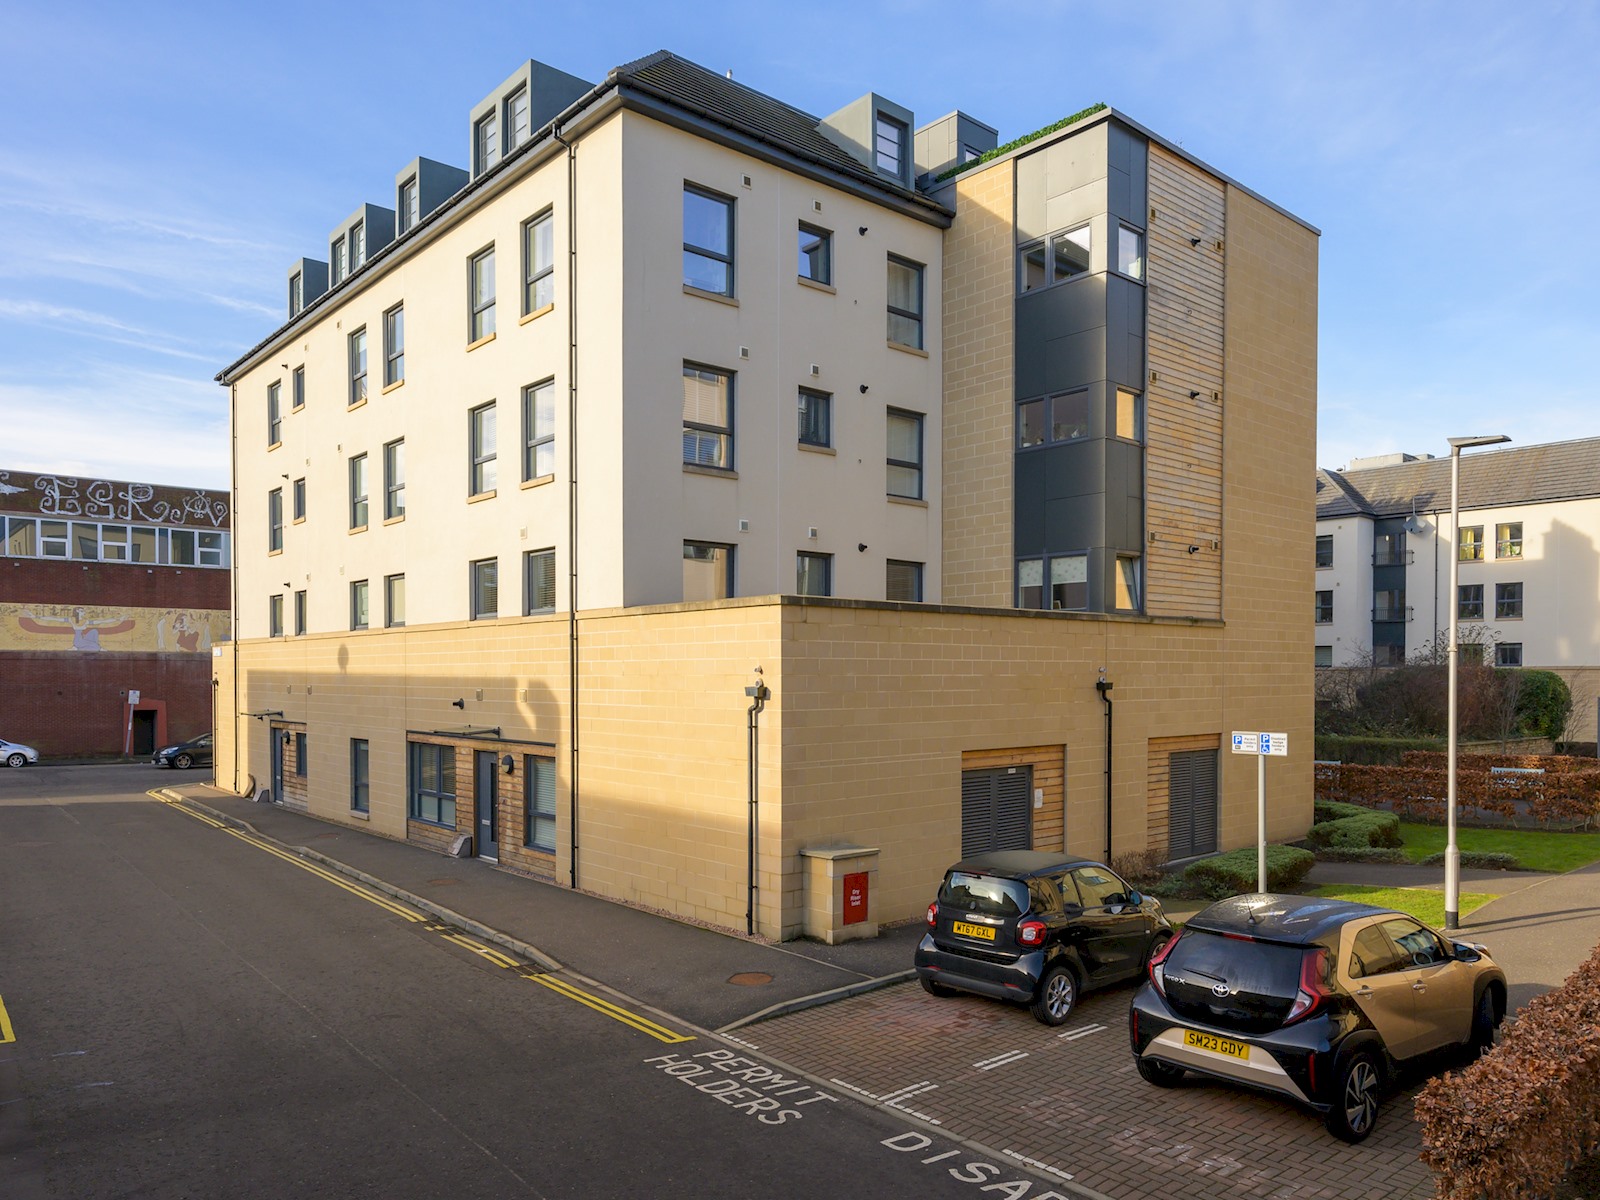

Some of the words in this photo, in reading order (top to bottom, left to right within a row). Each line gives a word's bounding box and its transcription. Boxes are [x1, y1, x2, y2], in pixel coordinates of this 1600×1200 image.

[976, 926, 991, 938] GXL
[1188, 1033, 1218, 1050] SM23
[1220, 1041, 1244, 1056] GDY
[643, 1053, 803, 1125] HOLDERS
[693, 1048, 840, 1106] PERMIT
